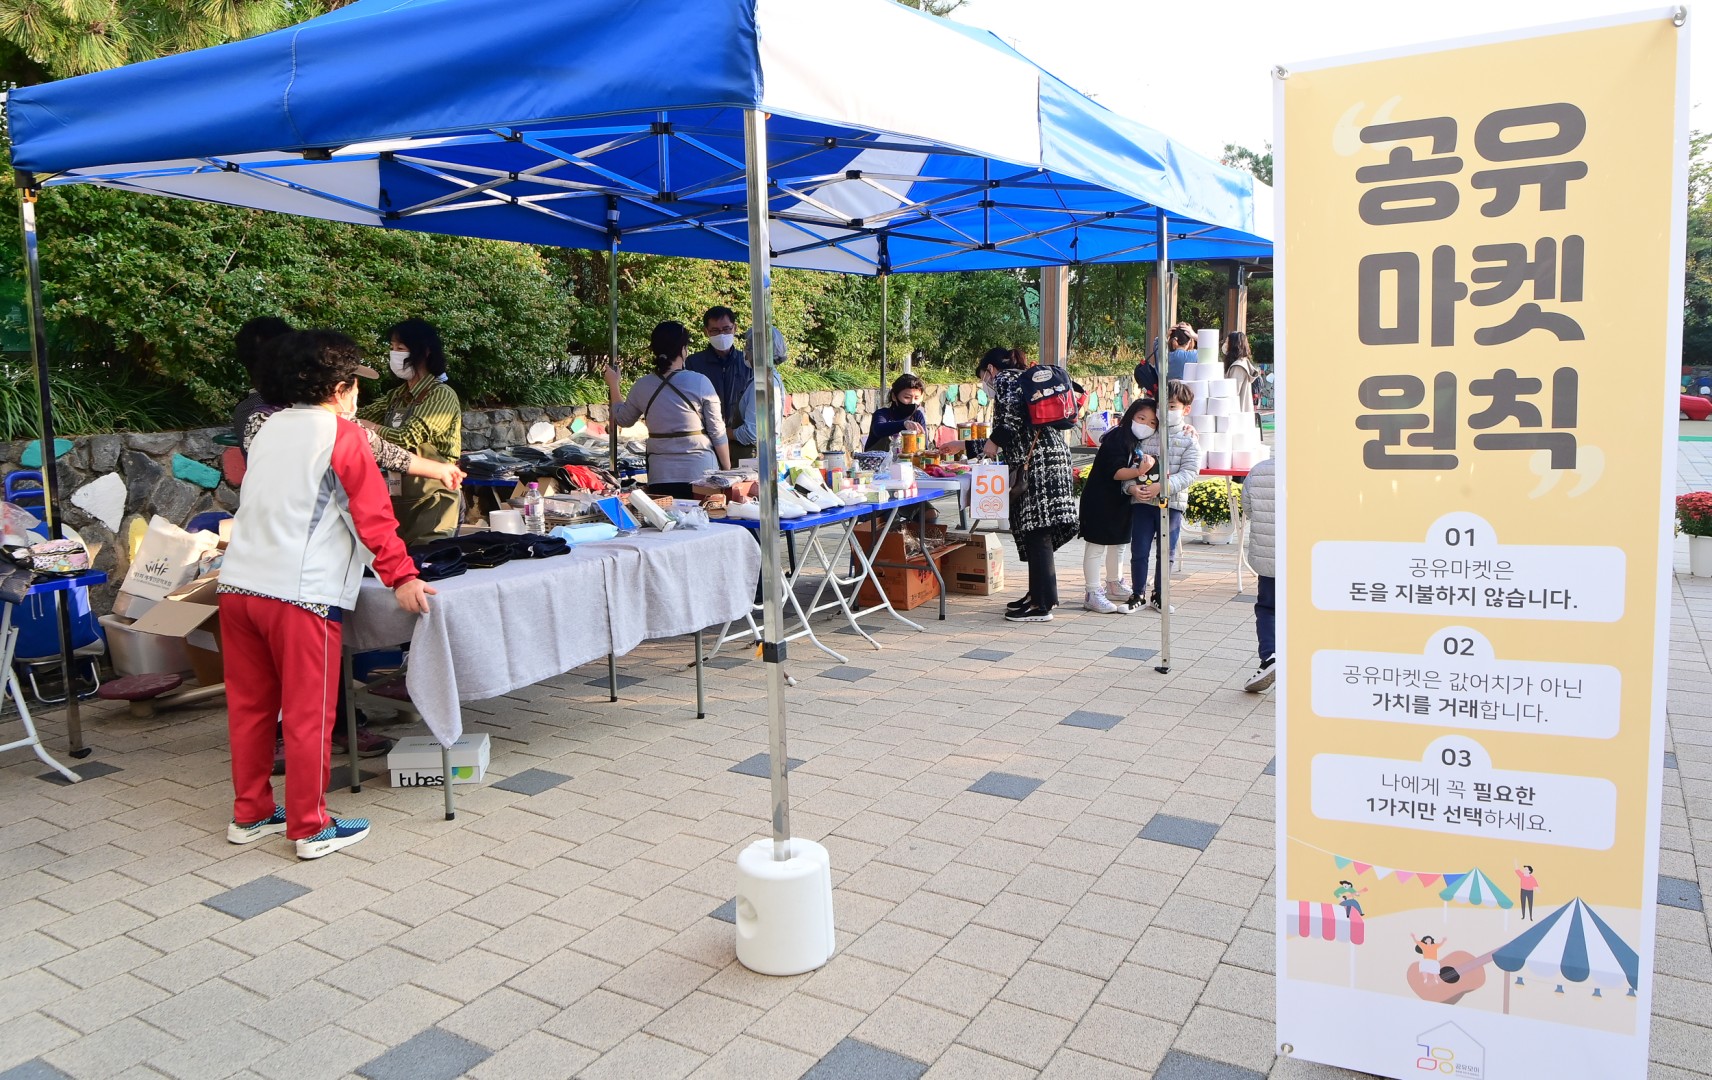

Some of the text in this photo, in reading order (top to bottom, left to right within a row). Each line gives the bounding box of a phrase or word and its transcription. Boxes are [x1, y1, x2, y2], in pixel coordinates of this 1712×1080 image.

[1355, 103, 1588, 226] 공유
[1358, 235, 1586, 347] 마켓
[1355, 367, 1579, 470] 원칙
[976, 475, 1005, 495] 50
[1445, 528, 1475, 547] 01
[1409, 558, 1515, 581] 공유마켓은
[1349, 582, 1578, 610] 돈을 지불하지 않습니다.
[1443, 637, 1475, 656] 02
[1342, 665, 1583, 700] 공유마켓은 값어치가 아닌
[1372, 692, 1549, 723] 가치를 거래합니다.
[1441, 748, 1472, 768] 03
[1381, 773, 1536, 806] 나에게 꼭 필요한
[1366, 798, 1553, 833] 1가지만 선택하세요.
